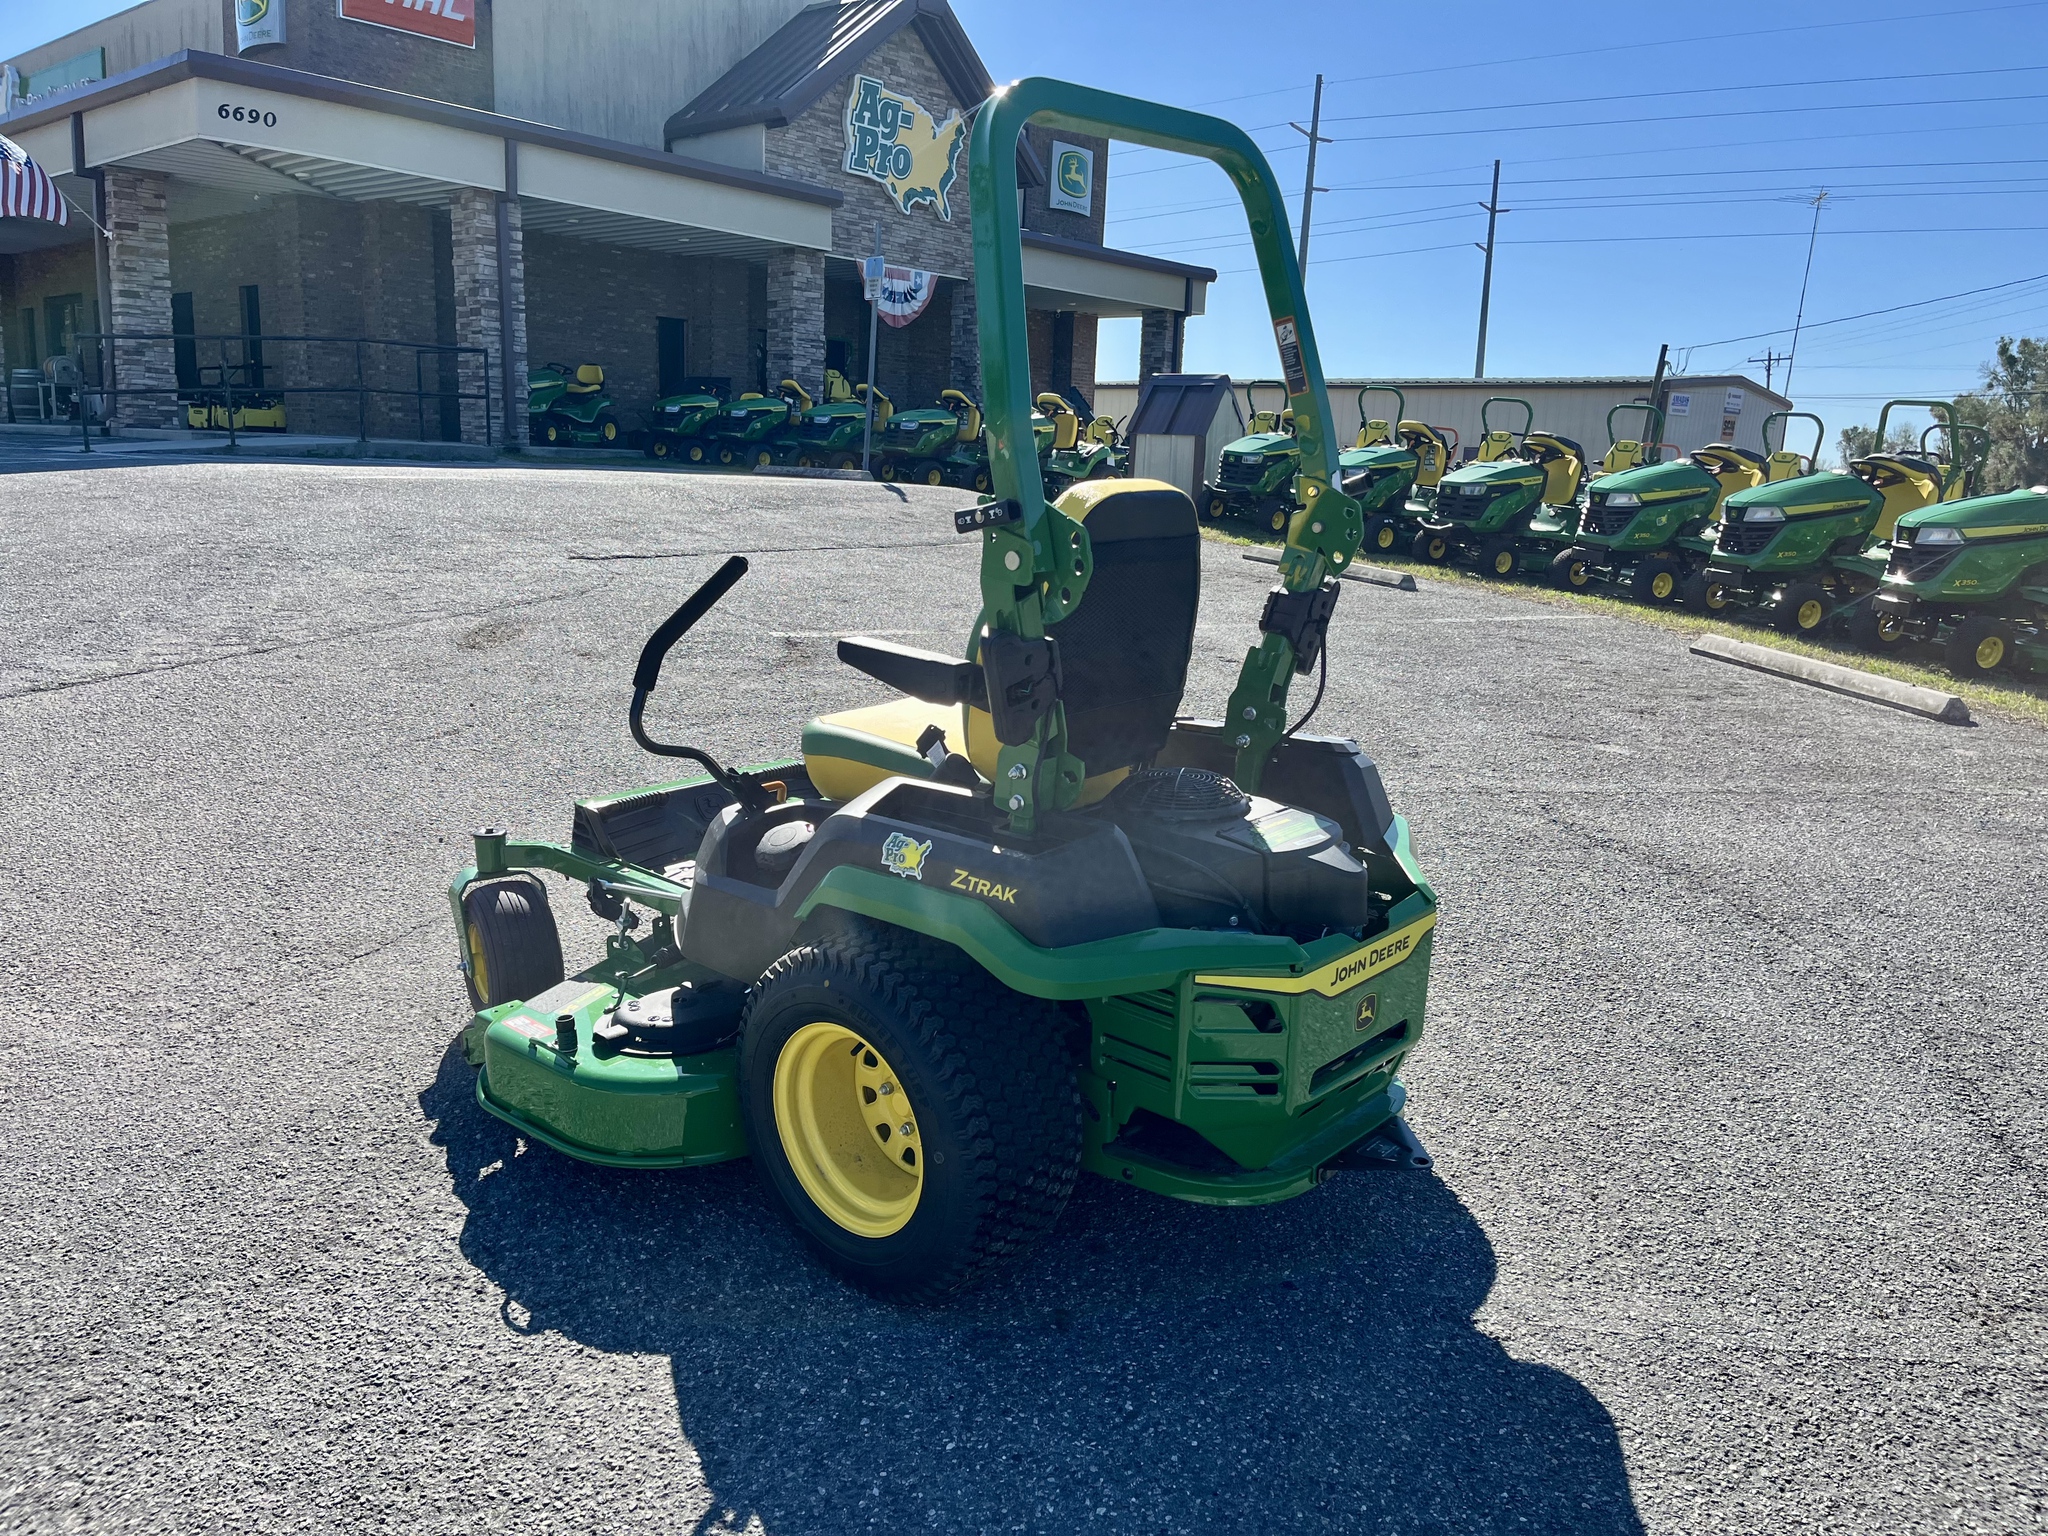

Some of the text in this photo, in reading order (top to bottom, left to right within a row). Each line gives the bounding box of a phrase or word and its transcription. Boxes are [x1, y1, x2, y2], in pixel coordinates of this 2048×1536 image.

[217, 103, 277, 128] 6690
[850, 123, 913, 180] Pro
[1056, 199, 1088, 212] JOHN DEERE
[1776, 551, 1797, 559] X350
[1953, 579, 1978, 587] X350
[885, 847, 905, 864] Pro
[951, 868, 1018, 904] ZTRAK
[1330, 935, 1410, 987] JOHN DEERE
